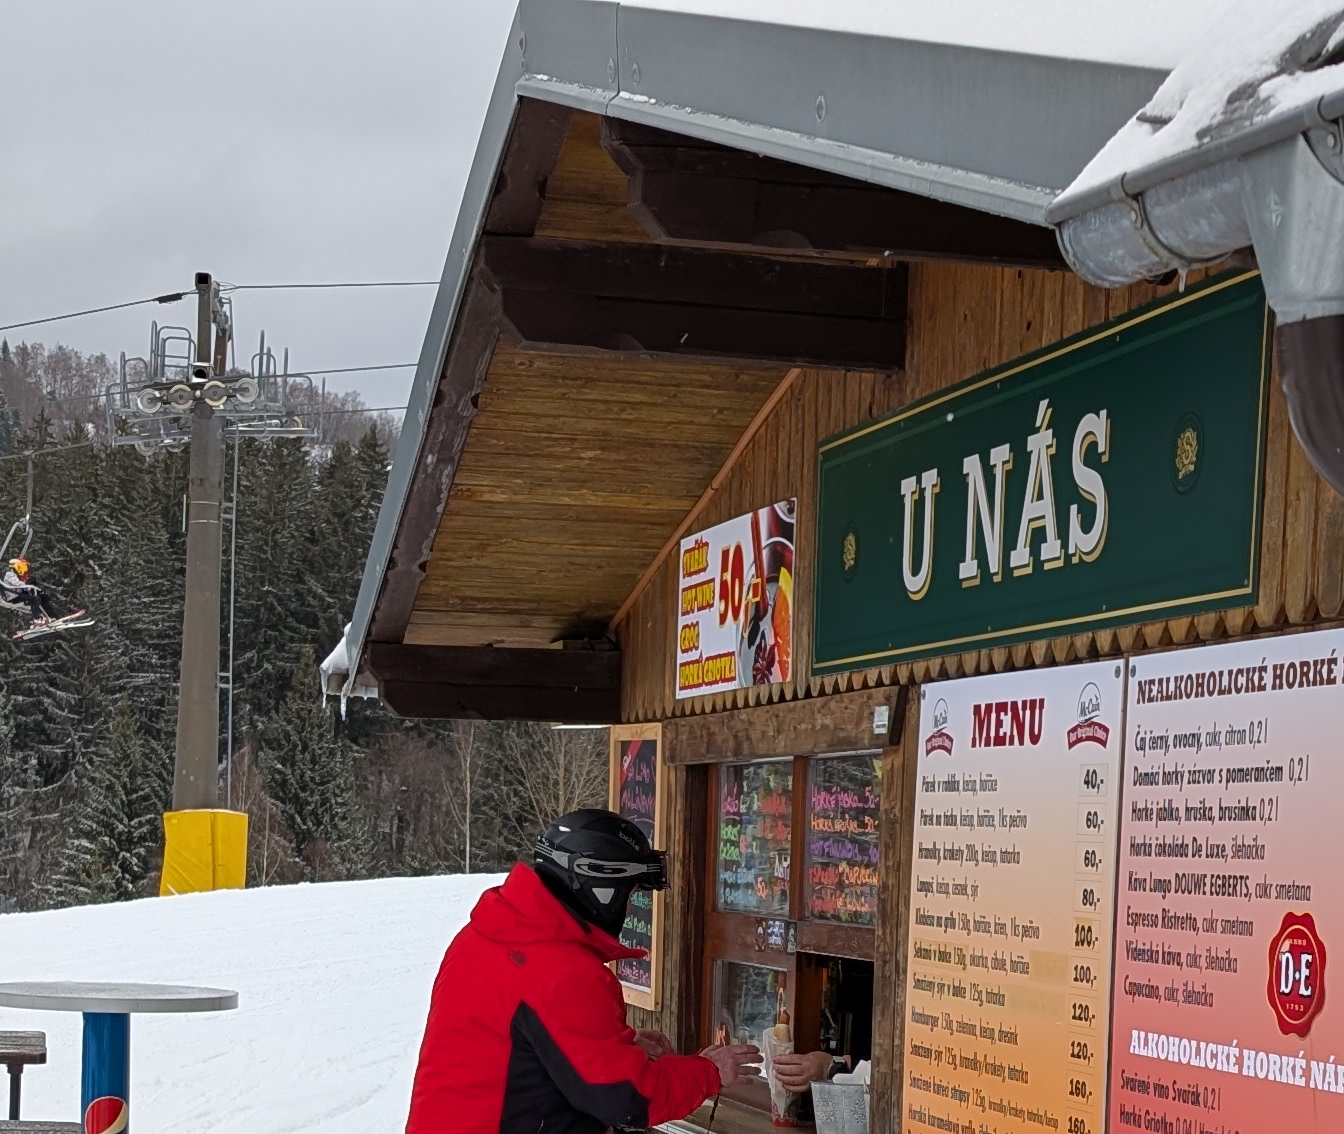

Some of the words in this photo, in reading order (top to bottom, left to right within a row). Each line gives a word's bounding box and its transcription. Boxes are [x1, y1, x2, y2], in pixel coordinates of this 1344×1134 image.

[900, 467, 940, 600] U
[959, 398, 1110, 588] NÁS
[679, 621, 700, 654] GROG
[679, 650, 703, 691] HORKÁ
[703, 651, 736, 687] GRIOTKA
[1136, 657, 1268, 705] NEALKOHOLICKÉ
[1271, 649, 1338, 691] HORKÉ
[971, 698, 1045, 748] MENU
[1135, 724, 1146, 758] Čaj
[1149, 728, 1170, 756] černý,
[1173, 726, 1202, 754] ovocný,
[1205, 722, 1222, 751] cukr,
[1224, 724, 1247, 746] citron
[1248, 720, 1263, 749] 0,2
[1084, 769, 1104, 794] 40,-
[1129, 836, 1152, 857] Horká
[1155, 835, 1189, 858] čokoláda
[1191, 836, 1203, 859] De
[1205, 836, 1229, 863] Luxe,
[1231, 835, 1266, 860] šlehačka
[1082, 889, 1100, 911] 80,-
[1128, 870, 1147, 892] Káva
[1149, 872, 1172, 900] Lungo
[1174, 872, 1207, 896] DOUWE
[1209, 874, 1253, 902] EGBERTS,
[1255, 874, 1272, 900] cukr
[1275, 879, 1311, 902] smetana
[1075, 924, 1099, 949] 100,-
[1073, 964, 1097, 988] 100,-
[1072, 1003, 1095, 1027] 120,-
[1070, 1041, 1094, 1064] 120,-
[1129, 1029, 1240, 1075] ALKOHOLICKÉ
[1241, 1050, 1306, 1087] HORKÉ
[1068, 1079, 1092, 1103] 160,-
[1120, 1069, 1151, 1095] Svařené
[1153, 1077, 1170, 1100] víno
[1171, 1079, 1201, 1107] Svařák
[1203, 1086, 1217, 1114] 0,2
